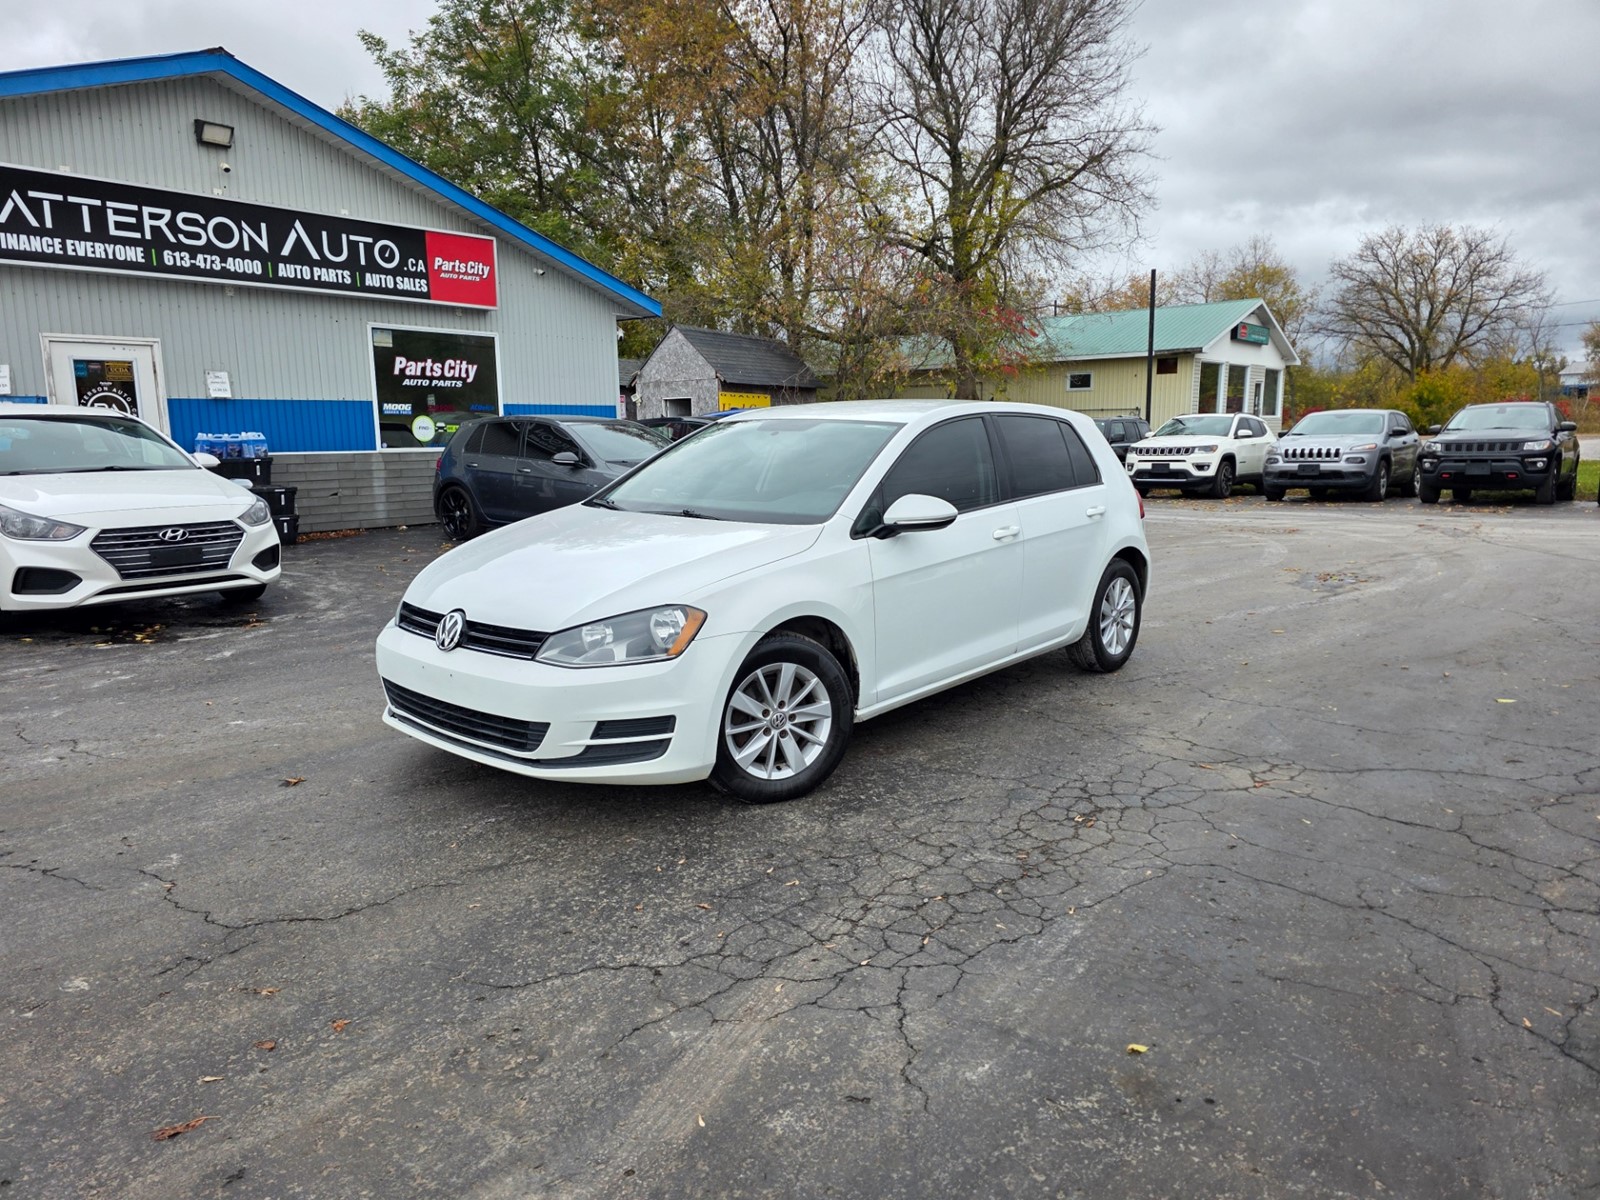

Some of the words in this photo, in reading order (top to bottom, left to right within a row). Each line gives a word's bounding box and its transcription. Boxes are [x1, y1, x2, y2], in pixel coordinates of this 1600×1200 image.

[280, 218, 400, 269] AUTO
[0, 232, 63, 255] INANCE
[66, 238, 145, 263] EVERYONE
[163, 250, 262, 275] 613-473-4000
[278, 263, 313, 281] AUTO
[314, 267, 351, 284] PARTS
[365, 272, 395, 289] AUTO
[396, 276, 428, 292] SALES
[458, 274, 480, 282] PARTS
[402, 379, 430, 387] AUTO
[431, 380, 463, 388] PARTS
[80, 386, 109, 406] TERSON
[383, 403, 412, 411] MOOG
